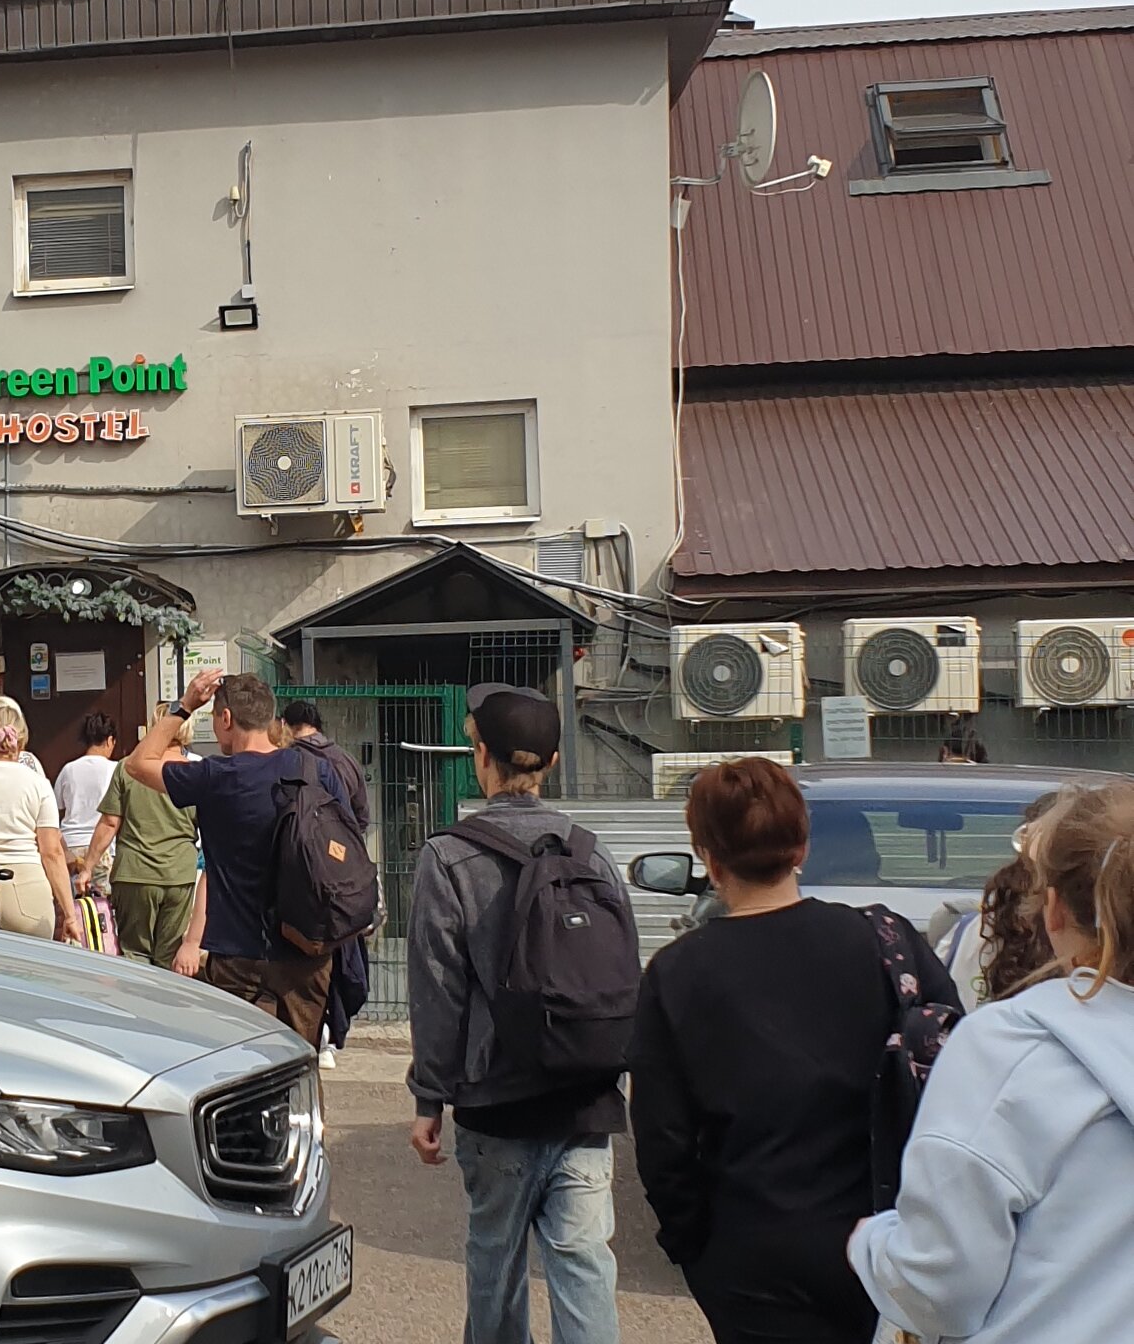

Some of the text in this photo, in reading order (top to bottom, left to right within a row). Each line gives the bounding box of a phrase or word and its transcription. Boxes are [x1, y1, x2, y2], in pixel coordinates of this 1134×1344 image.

[89, 353, 187, 397] Point
[350, 424, 360, 479] KRAFT
[166, 656, 222, 666] Gren Point
